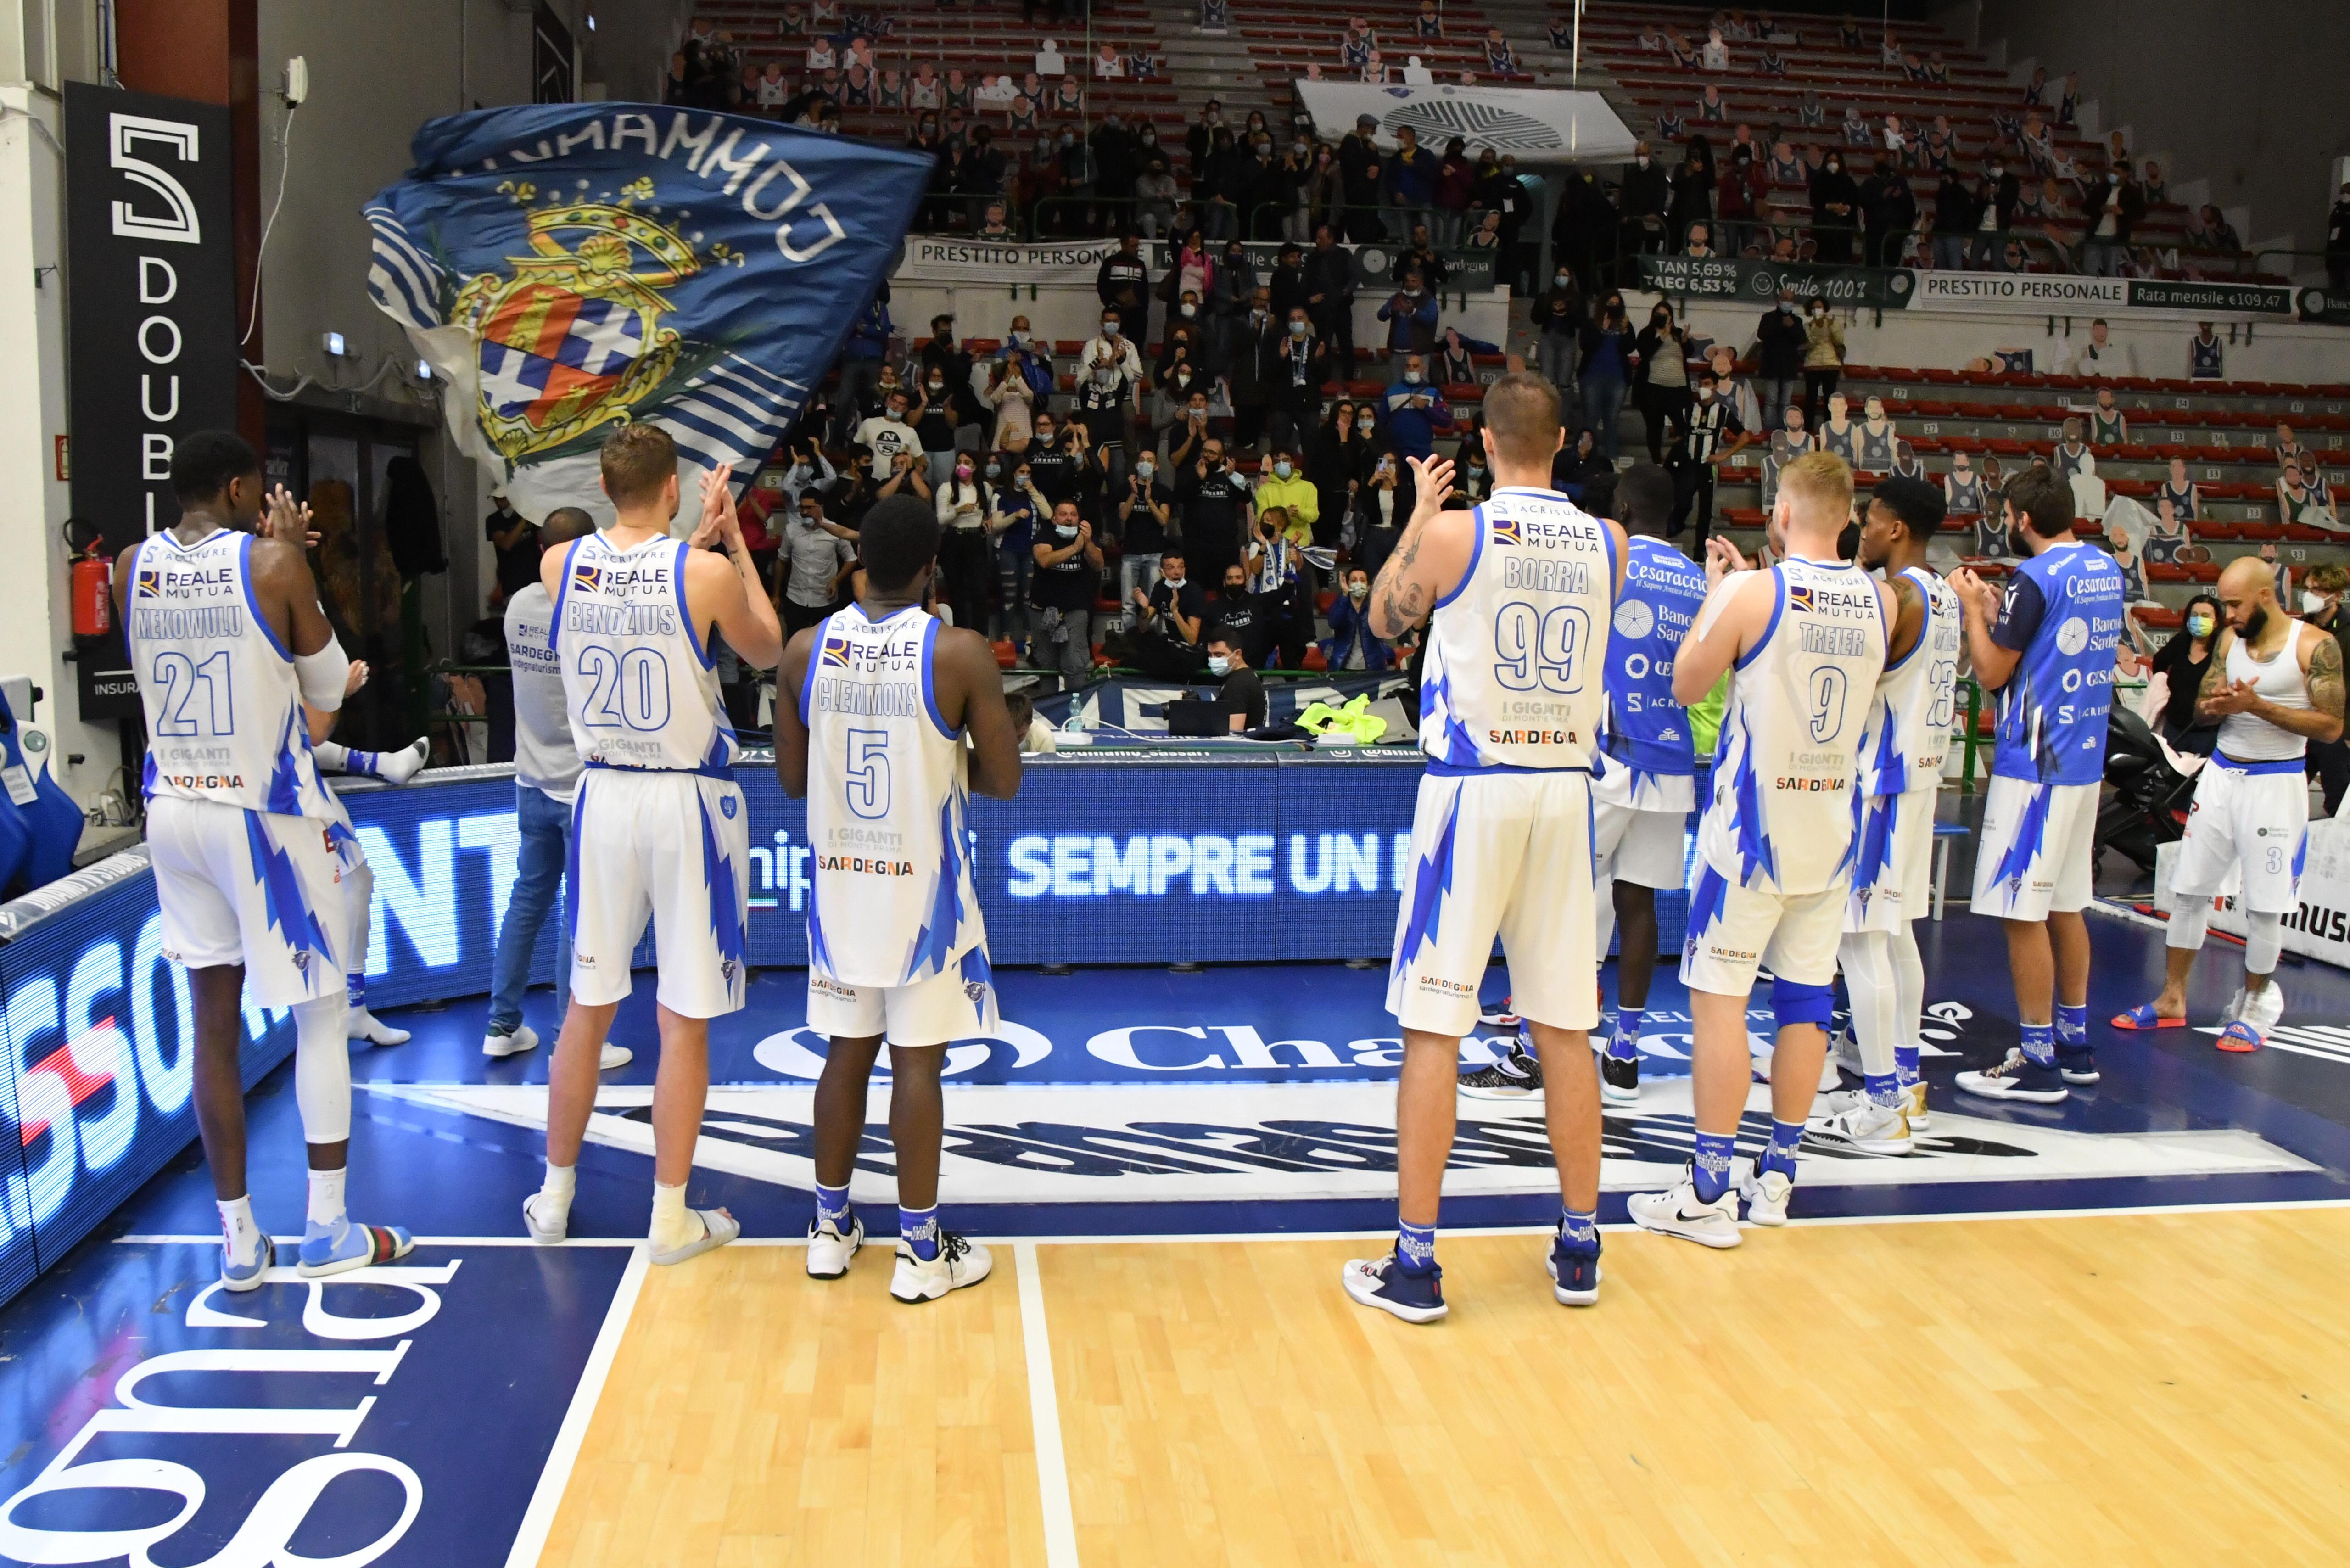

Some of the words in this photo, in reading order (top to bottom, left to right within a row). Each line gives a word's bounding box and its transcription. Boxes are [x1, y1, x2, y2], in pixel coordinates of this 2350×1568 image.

[922, 245, 1019, 264] PRESTITO
[1029, 247, 1145, 265] PERSONE
[1442, 258, 1488, 273] ardegna
[1656, 261, 1687, 274] TAN
[1692, 263, 1722, 277] 5,69
[1644, 275, 1685, 290] TAEG
[1690, 278, 1721, 293] 6,53
[1777, 274, 1820, 297] Smile
[1928, 279, 2014, 296] PRESTITO
[2022, 281, 2121, 300] PERSONALE
[2137, 287, 2166, 302] Rata
[2171, 290, 2224, 305] mensile
[2229, 293, 2280, 308] €109,47
[1456, 409, 1467, 419] 19
[882, 432, 895, 442] N
[2333, 474, 2342, 482] 36
[1520, 505, 1588, 518] ACRISURE
[2249, 509, 2259, 517] 33
[1526, 523, 1597, 540] REALE
[1528, 538, 1599, 553] MUTUA
[166, 568, 233, 587] REALE
[606, 569, 668, 585] REALE
[1505, 556, 1588, 594] BORRA
[166, 585, 234, 599] MUTUA
[604, 585, 668, 597] MUTUA
[1818, 591, 1874, 608] REALE
[567, 599, 676, 636] BENDŽIUS
[1818, 606, 1874, 620] MUTUA
[135, 605, 243, 640] MEKOWULU
[529, 626, 549, 636] REAL
[1109, 621, 1122, 631] 11
[1494, 601, 1590, 694] 99
[1799, 622, 1865, 657] TREIER
[2156, 635, 2167, 644] 28
[510, 643, 560, 662] SARDEGN
[852, 641, 918, 660] REALE
[154, 650, 234, 737] 21
[578, 644, 671, 732] 20
[1926, 659, 1957, 727] 23
[818, 677, 918, 718] CLEMMONS
[1651, 698, 1682, 710] ACR
[1809, 665, 1847, 744] 9
[846, 728, 890, 820] 5
[838, 828, 902, 846] GIGANTI
[819, 855, 914, 876] SARDEGNA
[1008, 834, 1276, 897] SEMPRE
[1289, 833, 1379, 893] UN
[2266, 846, 2282, 874] 3
[2279, 901, 2350, 944] mus
[1711, 946, 1757, 959] SARDEGNA
[811, 979, 856, 997] SARDEGNA
[1421, 976, 1473, 992] SARDEGNA
